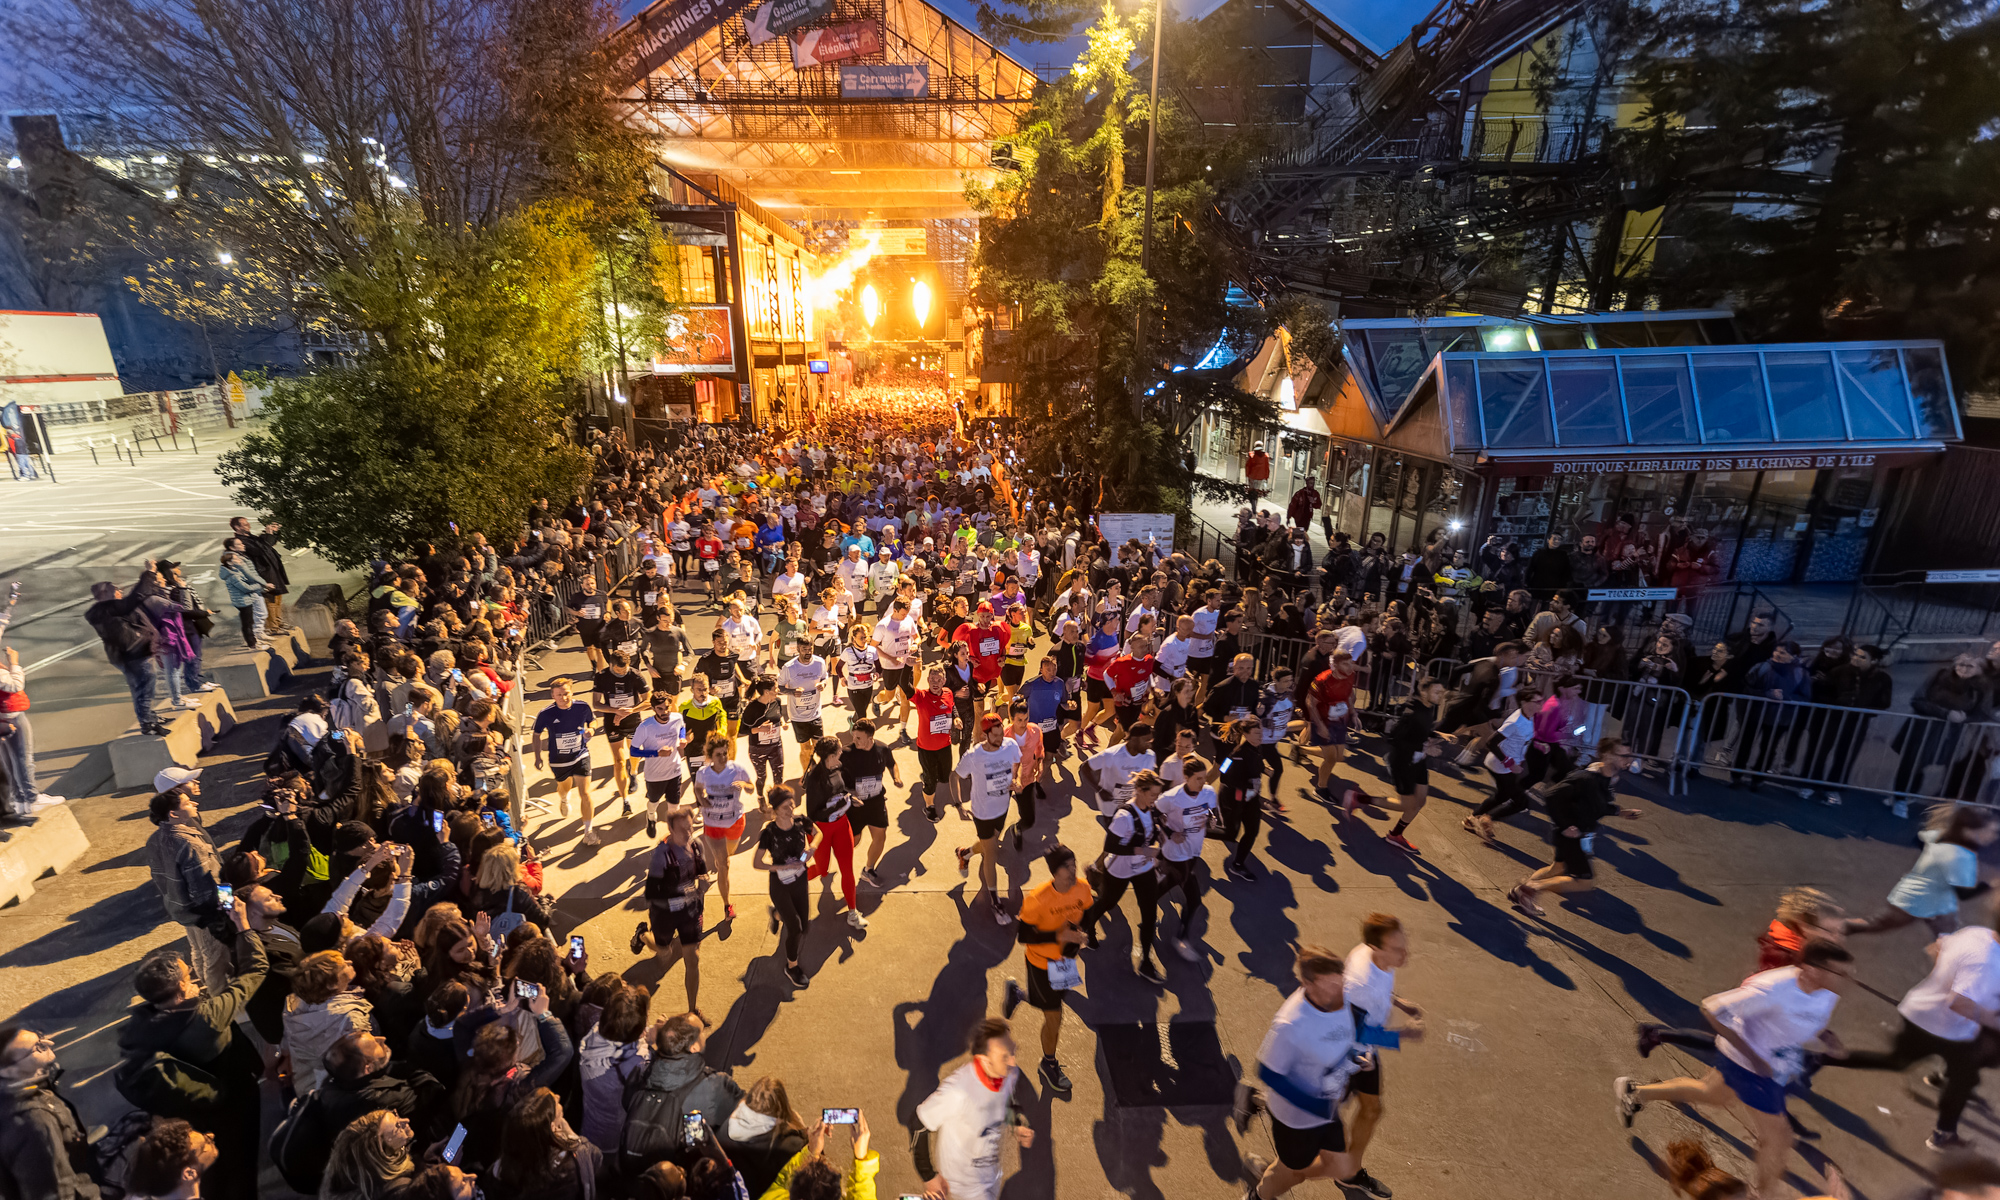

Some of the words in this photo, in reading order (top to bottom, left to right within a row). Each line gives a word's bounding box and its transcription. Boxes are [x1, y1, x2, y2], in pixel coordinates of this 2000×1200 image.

[636, 4, 712, 59] MACHINES
[819, 39, 859, 56] Éléphant
[860, 72, 904, 84] Carrousel
[1552, 459, 1701, 474] BOUTIQUE-LIBRAIRIE
[1705, 458, 1732, 471] DES
[1735, 456, 1812, 470] MACHINES
[1815, 455, 1836, 467] DE
[1607, 589, 1647, 598] TICKETS
